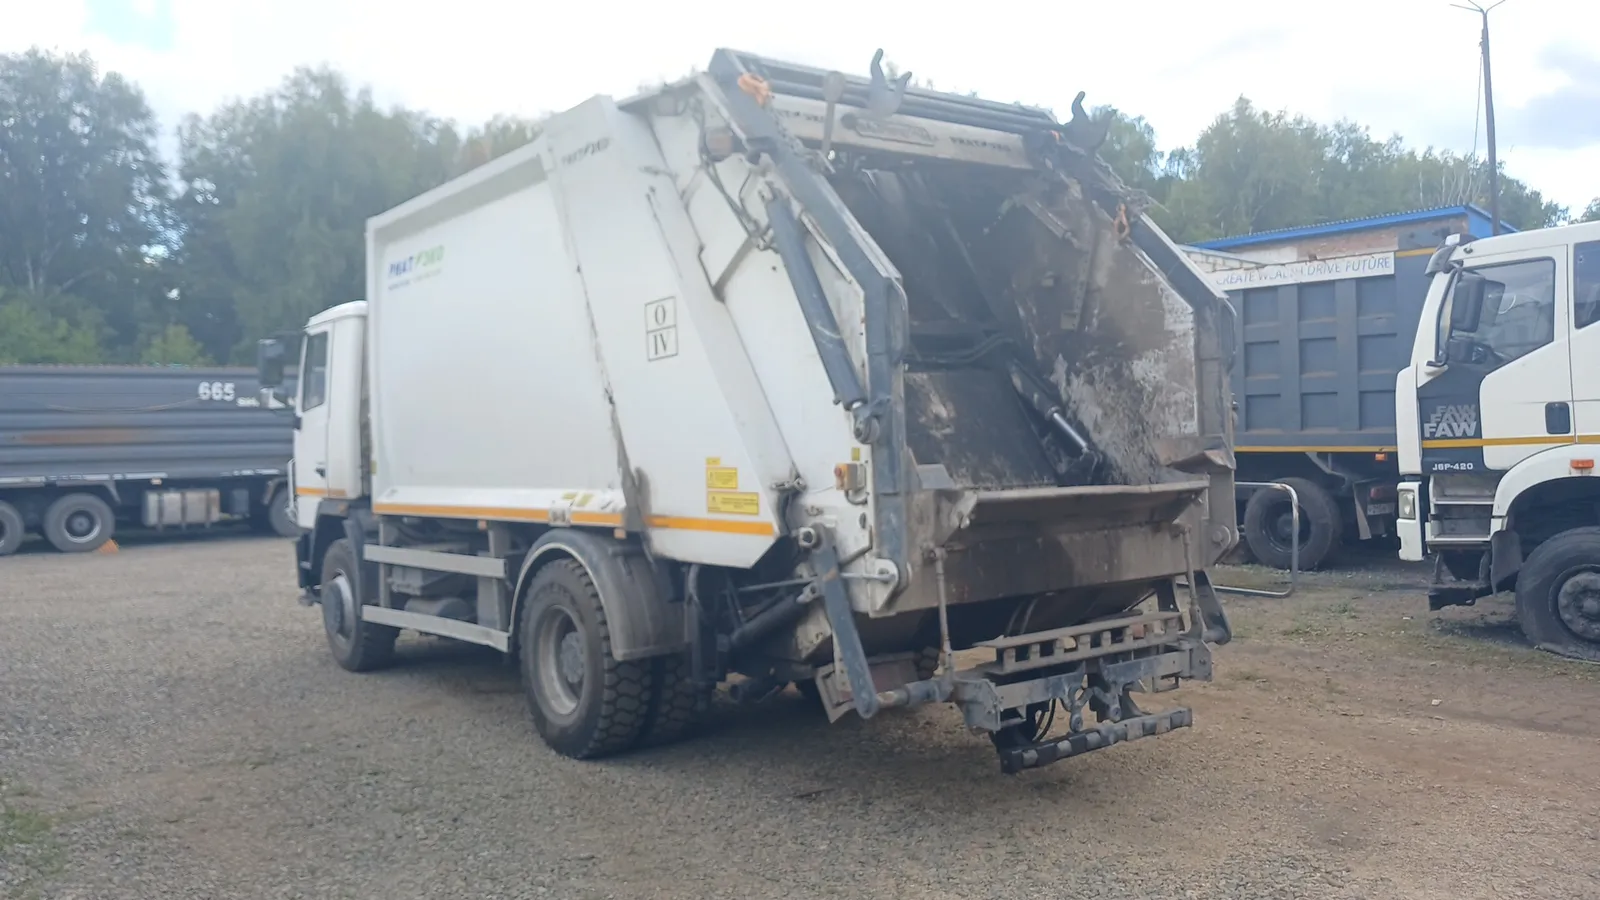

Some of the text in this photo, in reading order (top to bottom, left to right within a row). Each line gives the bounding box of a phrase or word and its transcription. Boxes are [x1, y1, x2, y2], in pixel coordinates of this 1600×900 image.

[1307, 262, 1342, 276] DRIVE
[1345, 256, 1391, 272] FUTURE
[198, 381, 235, 401] 665
[1436, 404, 1476, 415] FAW
[1423, 421, 1477, 437] FAW
